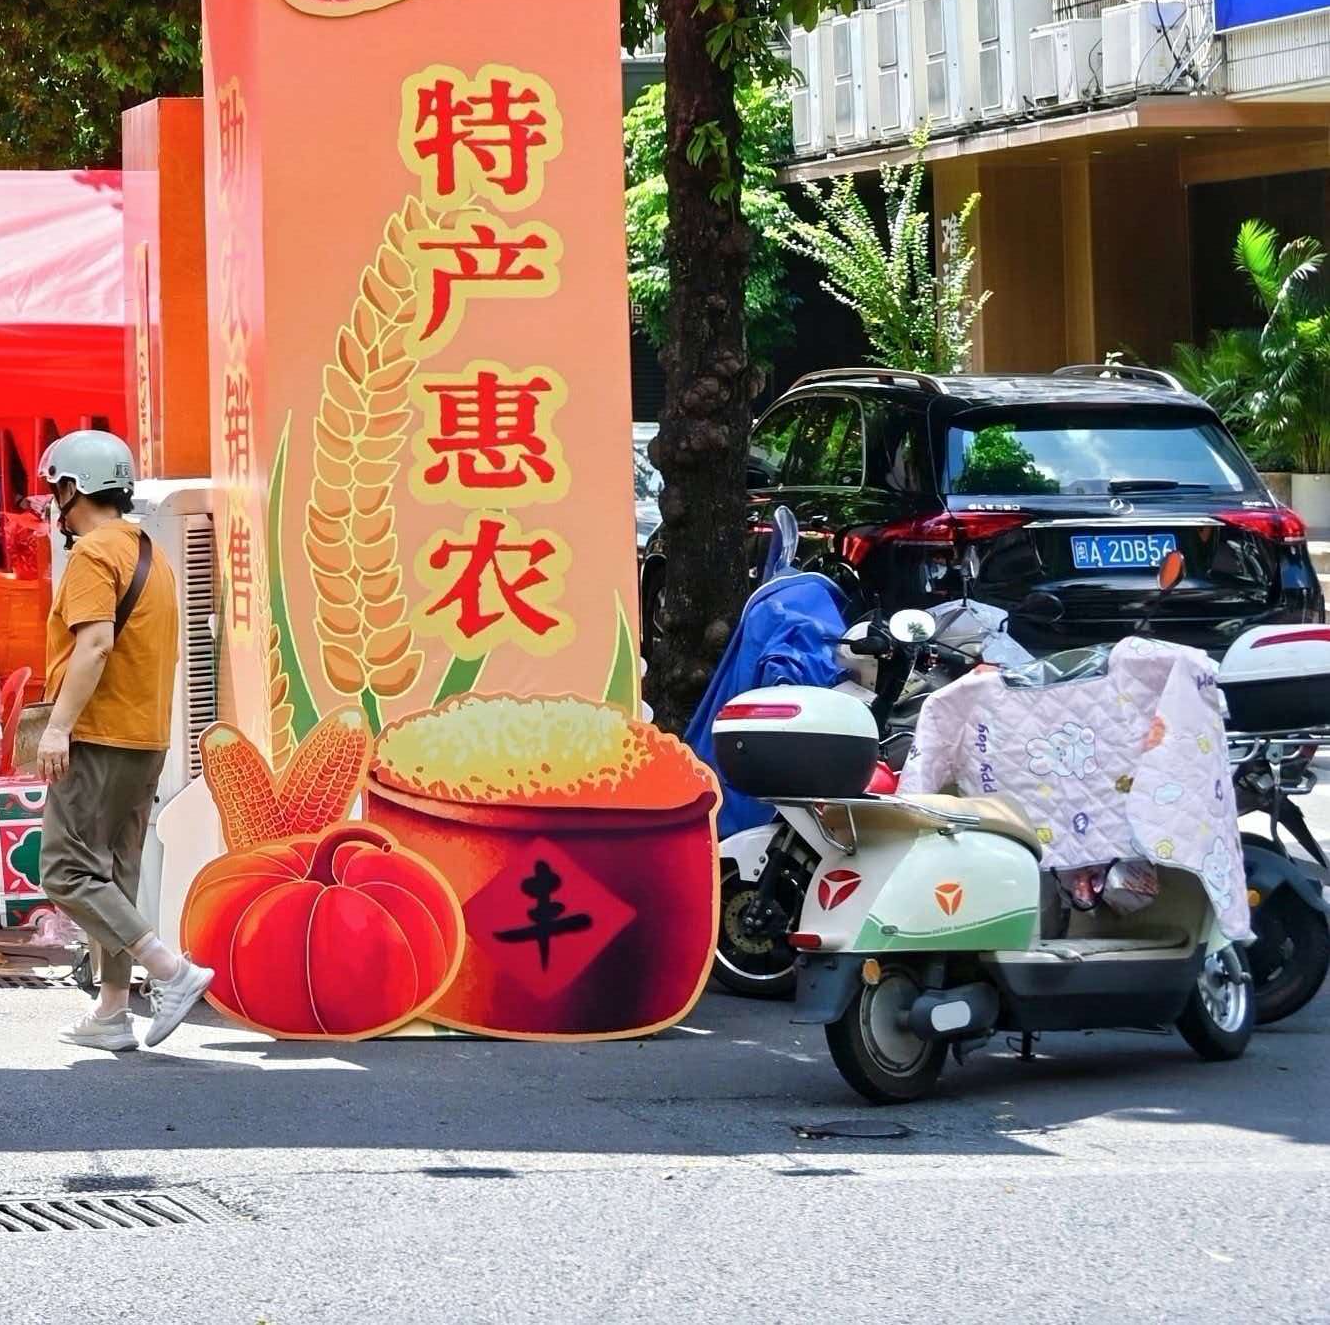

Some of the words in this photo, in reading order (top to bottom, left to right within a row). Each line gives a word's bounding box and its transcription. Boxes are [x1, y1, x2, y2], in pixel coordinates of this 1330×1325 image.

[218, 88, 253, 631] 助农销售
[414, 78, 559, 639] 特产惠农
[492, 859, 593, 972] 丰
